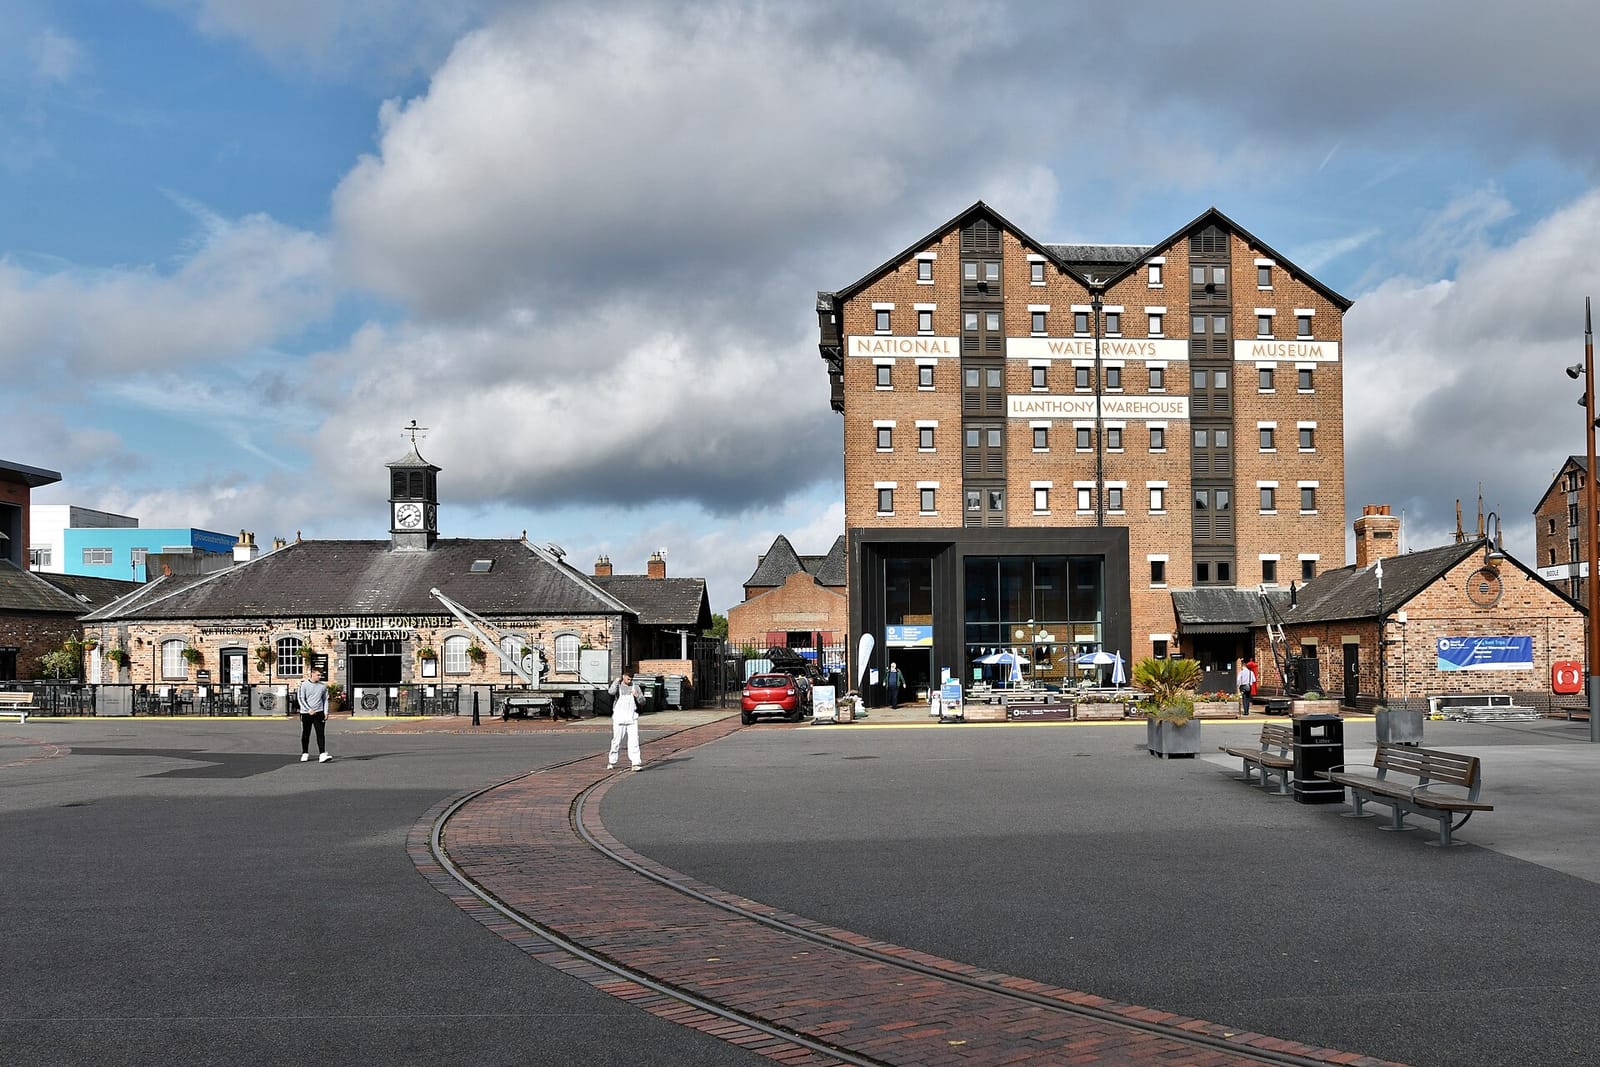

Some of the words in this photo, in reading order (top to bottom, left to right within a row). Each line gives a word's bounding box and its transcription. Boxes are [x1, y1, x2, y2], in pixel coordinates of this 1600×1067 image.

[857, 339, 950, 353] NATIONAL
[1048, 341, 1157, 356] WATERWAYS
[1252, 343, 1324, 358] MUSEUM
[1013, 401, 1095, 413] LLANTHONY
[1102, 402, 1184, 414] WAREHOUSE
[293, 617, 316, 629] THE
[320, 616, 350, 629] LORD
[355, 616, 384, 628] HIGH
[388, 616, 452, 628] CONSTABLE
[201, 627, 267, 635] WETHERSPOON
[338, 630, 352, 641] OF
[357, 629, 409, 641] ENGLAND
